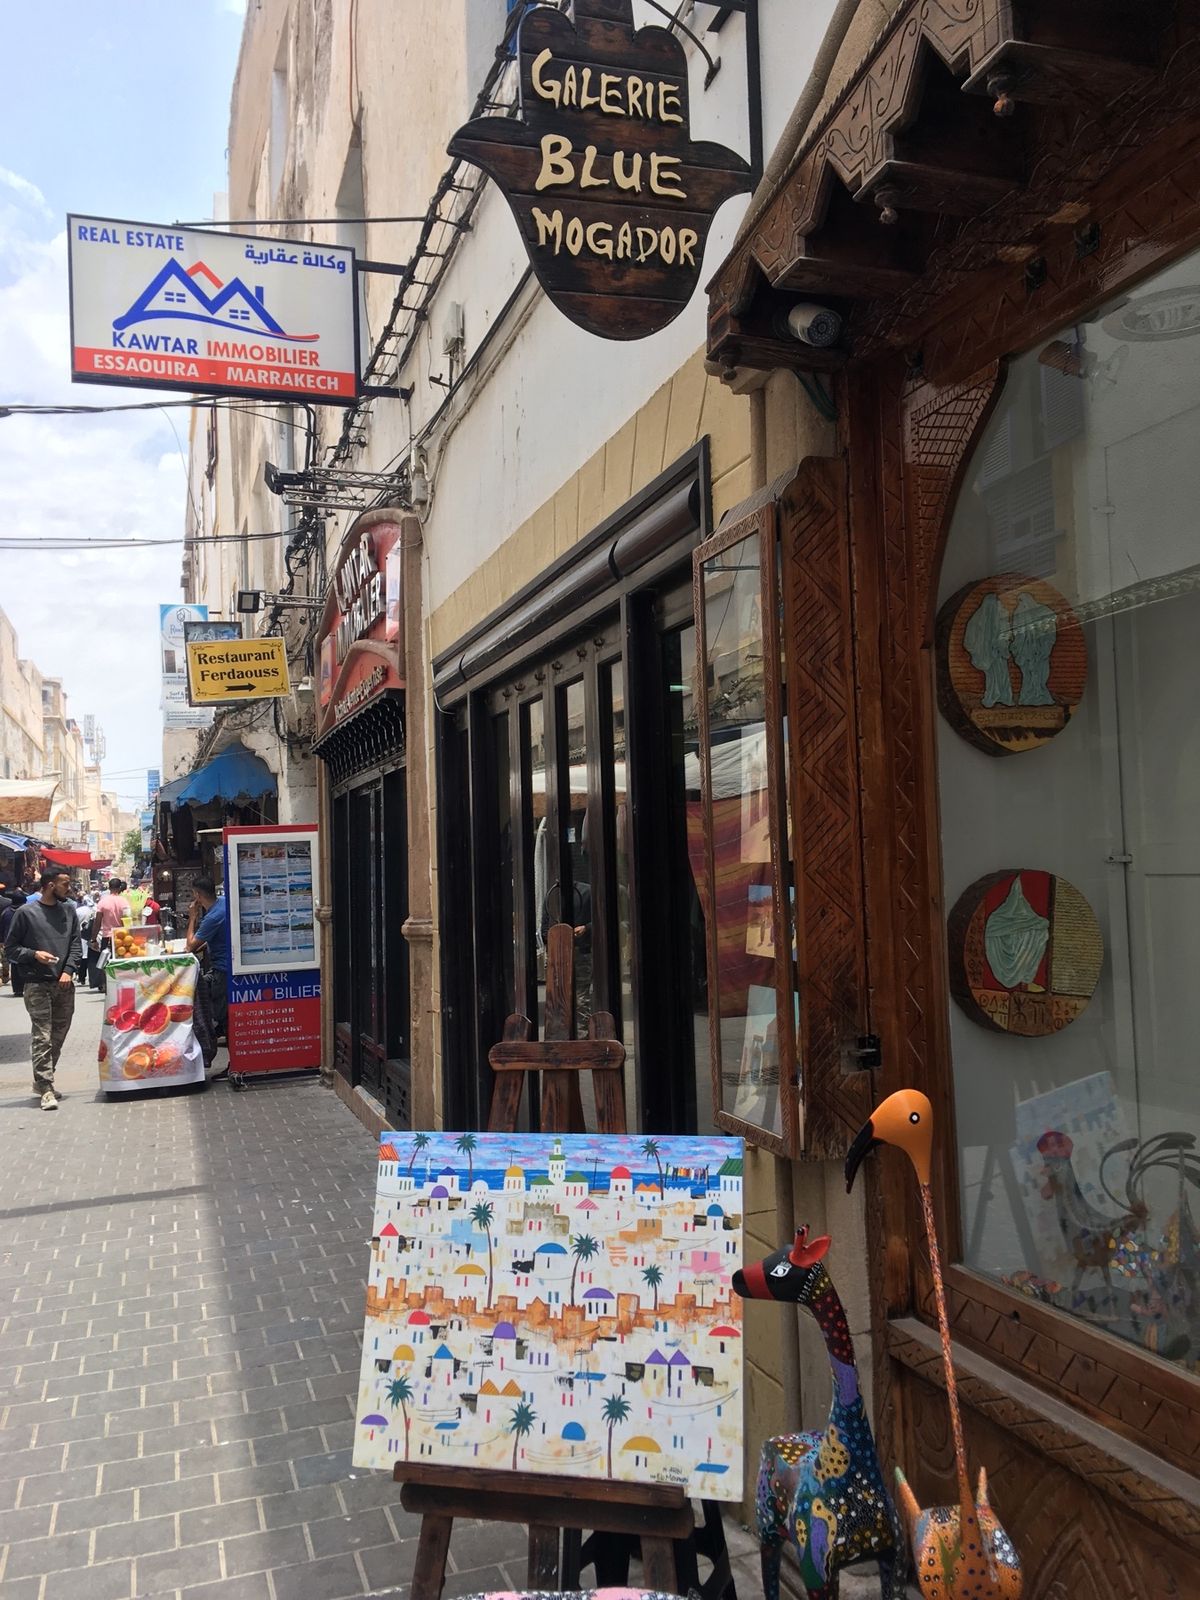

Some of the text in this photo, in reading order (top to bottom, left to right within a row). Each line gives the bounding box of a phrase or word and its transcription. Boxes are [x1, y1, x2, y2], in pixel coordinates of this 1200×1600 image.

[531, 48, 684, 123] GALERIE
[535, 134, 687, 199] BLUE
[78, 225, 184, 251] REAL ESTATE
[531, 207, 698, 267] MOGADOR
[245, 244, 346, 274] وكالة عقارية
[112, 331, 320, 367] KAWTAR IMMOBILIER
[93, 354, 200, 378] ESSAOUIRA
[227, 366, 339, 391] MARRAKECH
[197, 649, 276, 664] Restaurant
[200, 667, 280, 682] Ferdaouss
